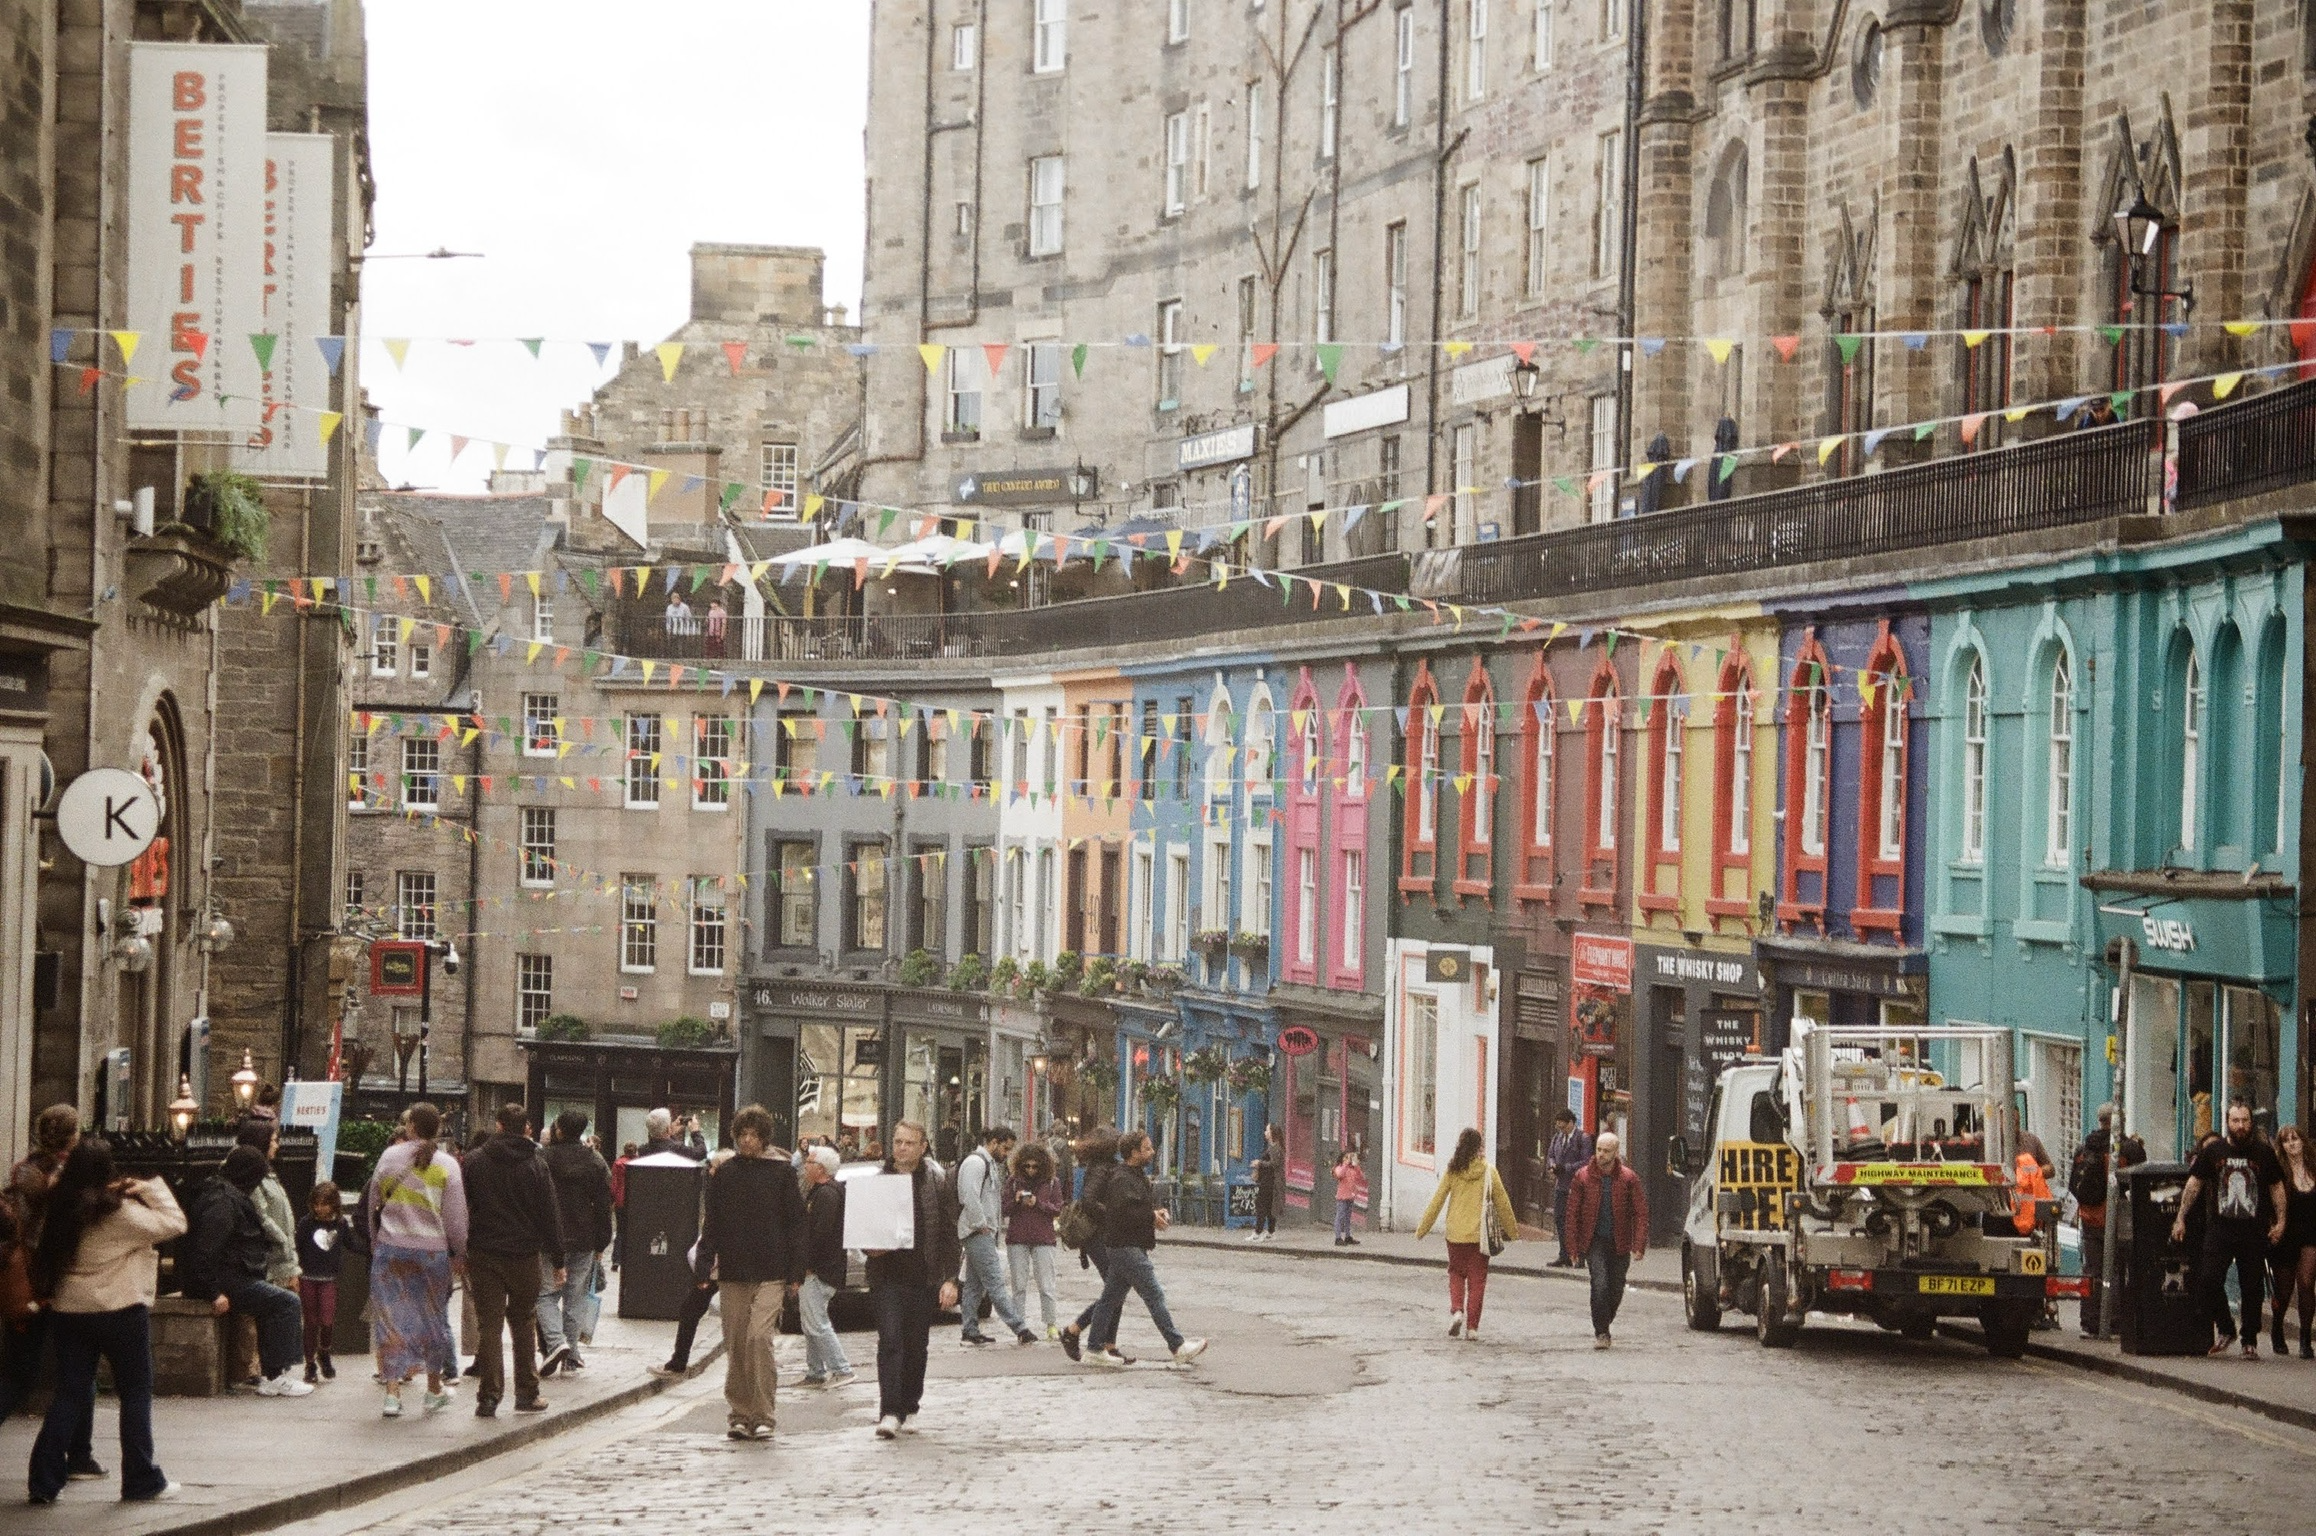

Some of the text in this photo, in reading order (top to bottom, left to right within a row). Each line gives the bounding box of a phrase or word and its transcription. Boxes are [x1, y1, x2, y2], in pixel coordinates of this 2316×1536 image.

[217, 73, 226, 132] PROPER
[214, 256, 223, 355] RESTAURANT
[105, 795, 140, 840] K
[2142, 917, 2195, 951] SWISH
[1657, 955, 1743, 984] THE WHISKY SHOP
[791, 992, 829, 1008] Walker
[836, 993, 870, 1010] Slater
[1704, 1035, 1751, 1046] WHISKY
[1716, 1019, 1739, 1031] THE
[1718, 1149, 1793, 1182] HIRE
[1860, 1168, 1979, 1179] HIGHWAY MAINTENANCE
